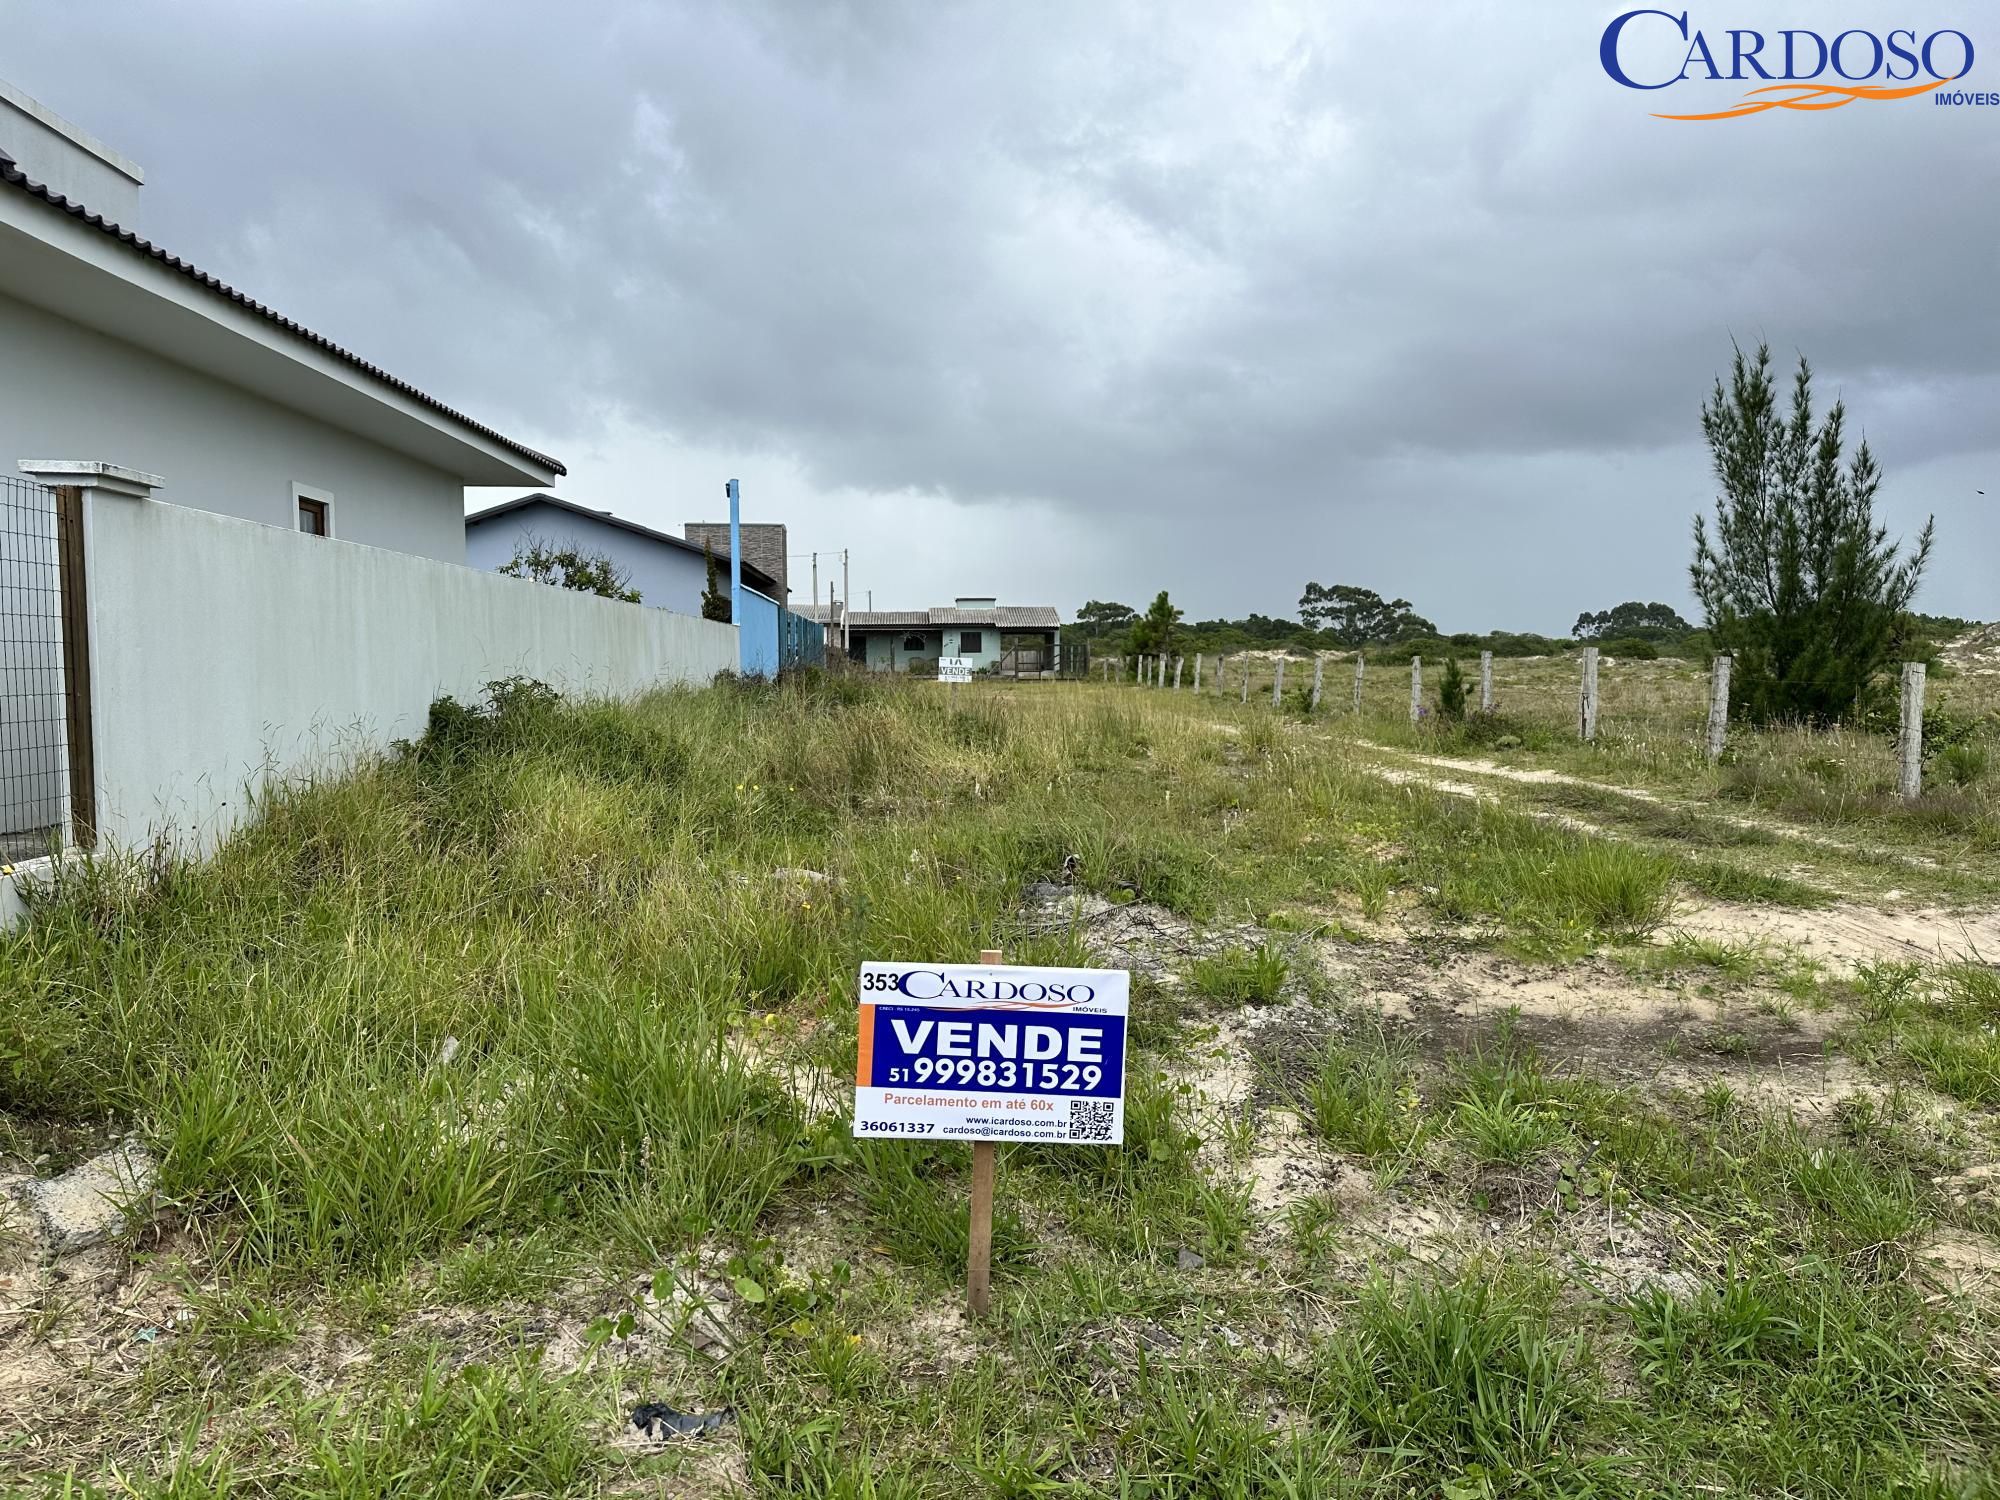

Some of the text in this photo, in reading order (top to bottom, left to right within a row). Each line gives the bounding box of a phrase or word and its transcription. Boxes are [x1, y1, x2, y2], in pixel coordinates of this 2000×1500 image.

[941, 667, 970, 675] VENDE
[862, 970, 1095, 1003] 353 CARDOSO
[1072, 1006, 1108, 1014] IMÓVEIS
[891, 1019, 1103, 1063] VENDE
[889, 1057, 1102, 1091] 51 999831529
[884, 1093, 1054, 1112] Parcelamento em até 60x
[860, 1121, 935, 1134] 36061337
[966, 1115, 1067, 1128] www.icardoso.com.br
[943, 1126, 1067, 1139] cardoso@icardoso.com.br
